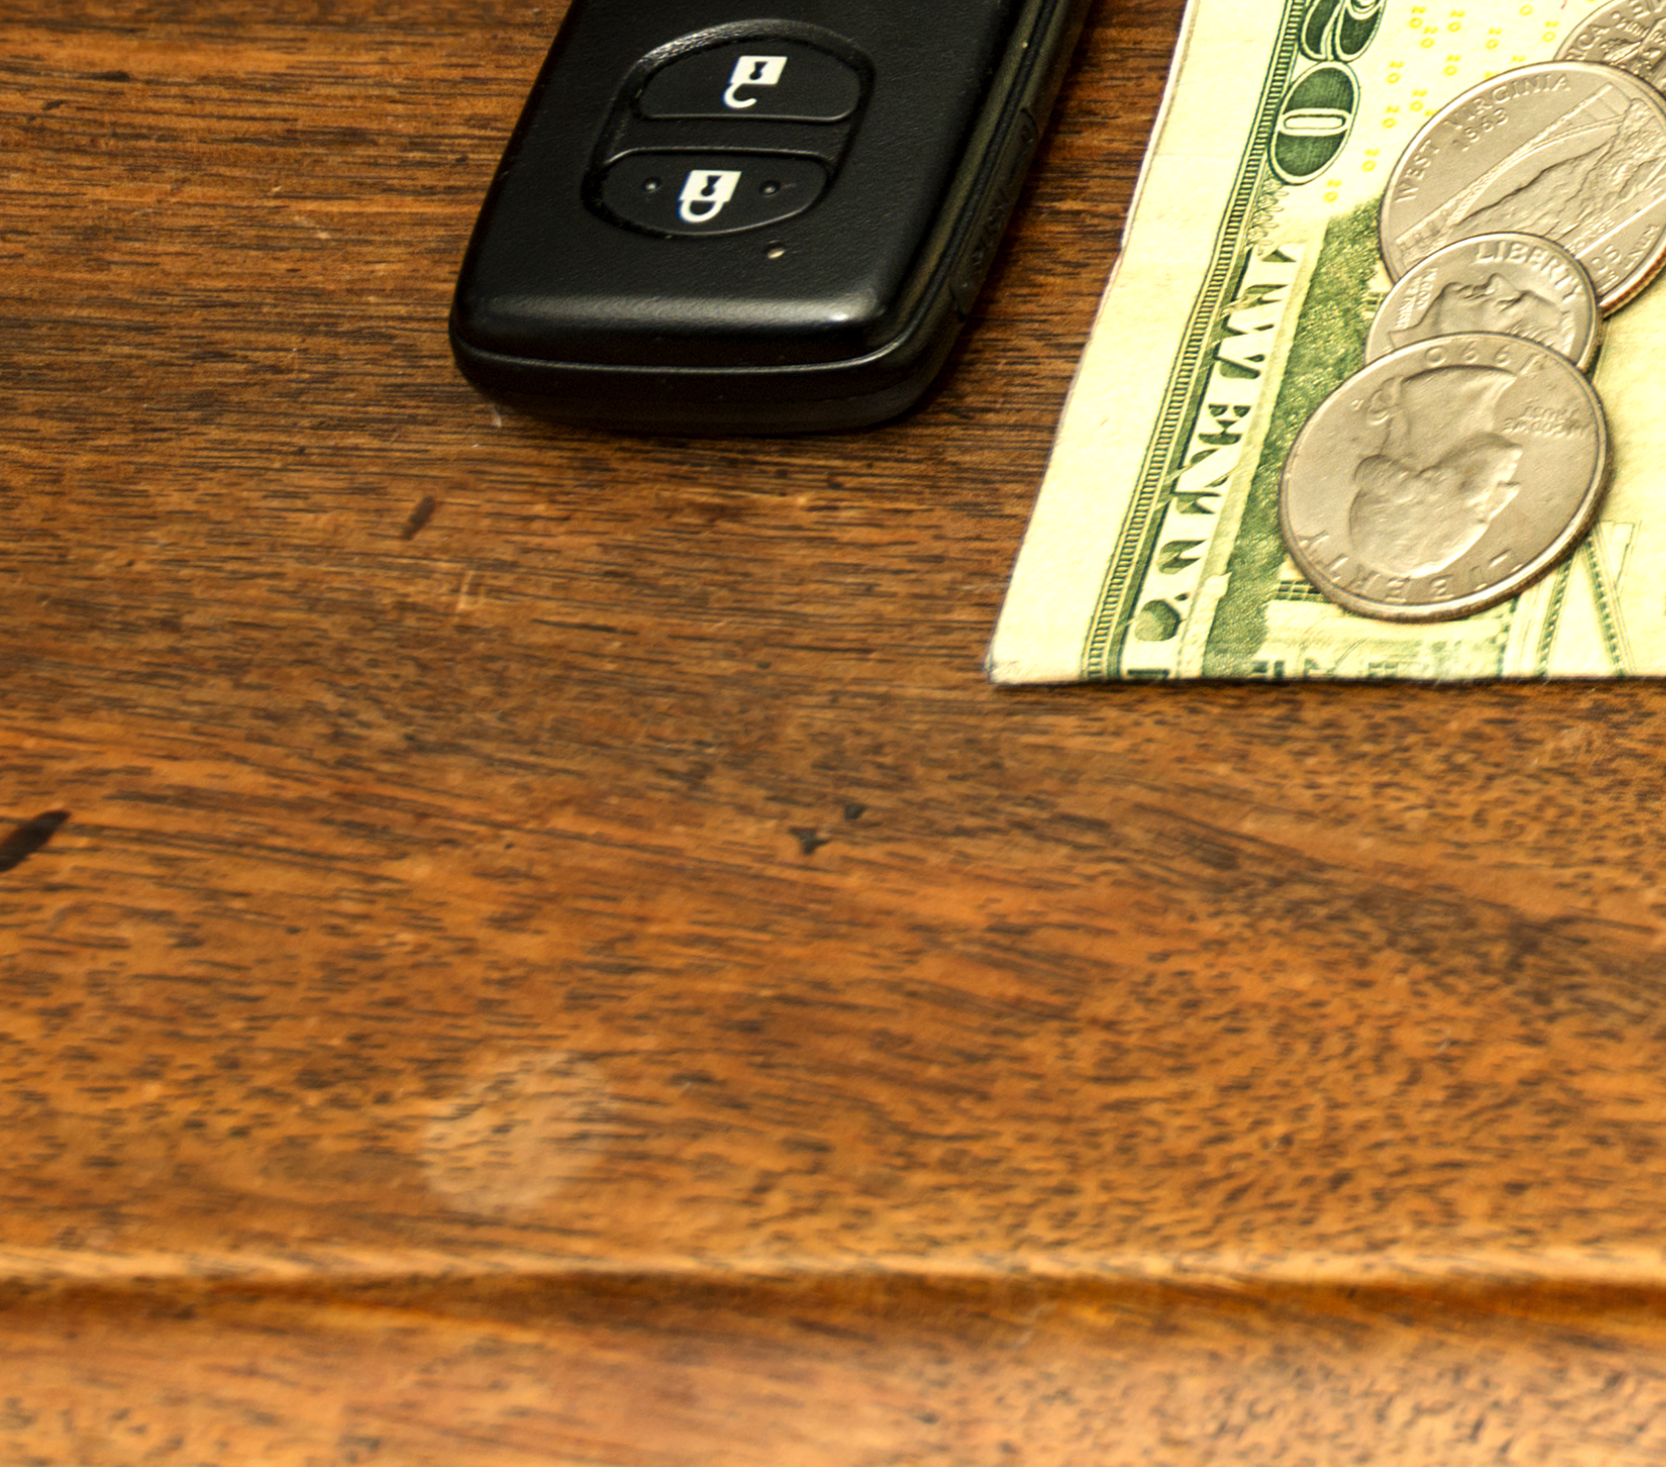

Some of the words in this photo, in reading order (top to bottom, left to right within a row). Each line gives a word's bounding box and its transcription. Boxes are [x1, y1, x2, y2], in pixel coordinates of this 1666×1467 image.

[1395, 139, 1440, 203] WEST
[1444, 73, 1571, 131] VIRGINIA
[1452, 107, 1509, 152] 1863
[1472, 240, 1582, 303] LIBERTY
[1424, 345, 1547, 379] 1990
[1132, 241, 1312, 635] TWENTY
[1299, 531, 1522, 602] LIBERTY
